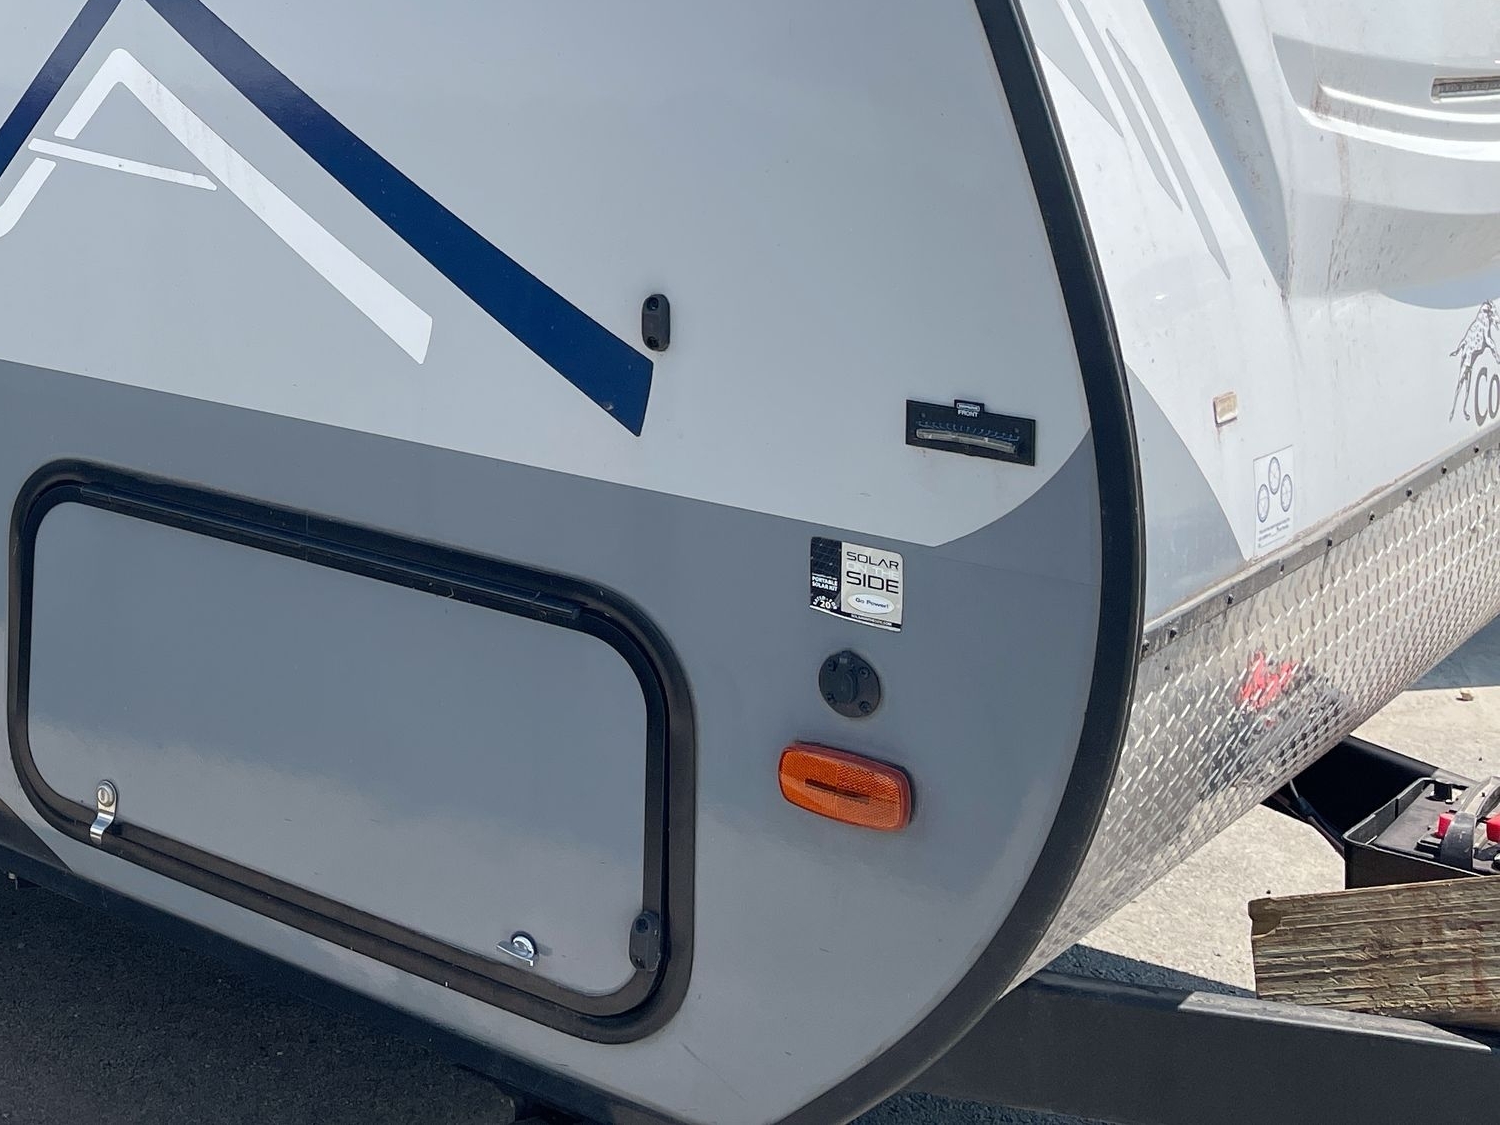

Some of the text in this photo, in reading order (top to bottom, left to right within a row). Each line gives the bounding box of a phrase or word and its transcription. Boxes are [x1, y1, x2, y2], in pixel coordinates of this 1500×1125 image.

[846, 551, 899, 571] SOLAR
[846, 561, 899, 579] ON THE
[811, 575, 838, 586] PORTABLE
[811, 581, 828, 590] SOLAR
[846, 570, 899, 594] SIDE
[819, 600, 831, 609] 20
